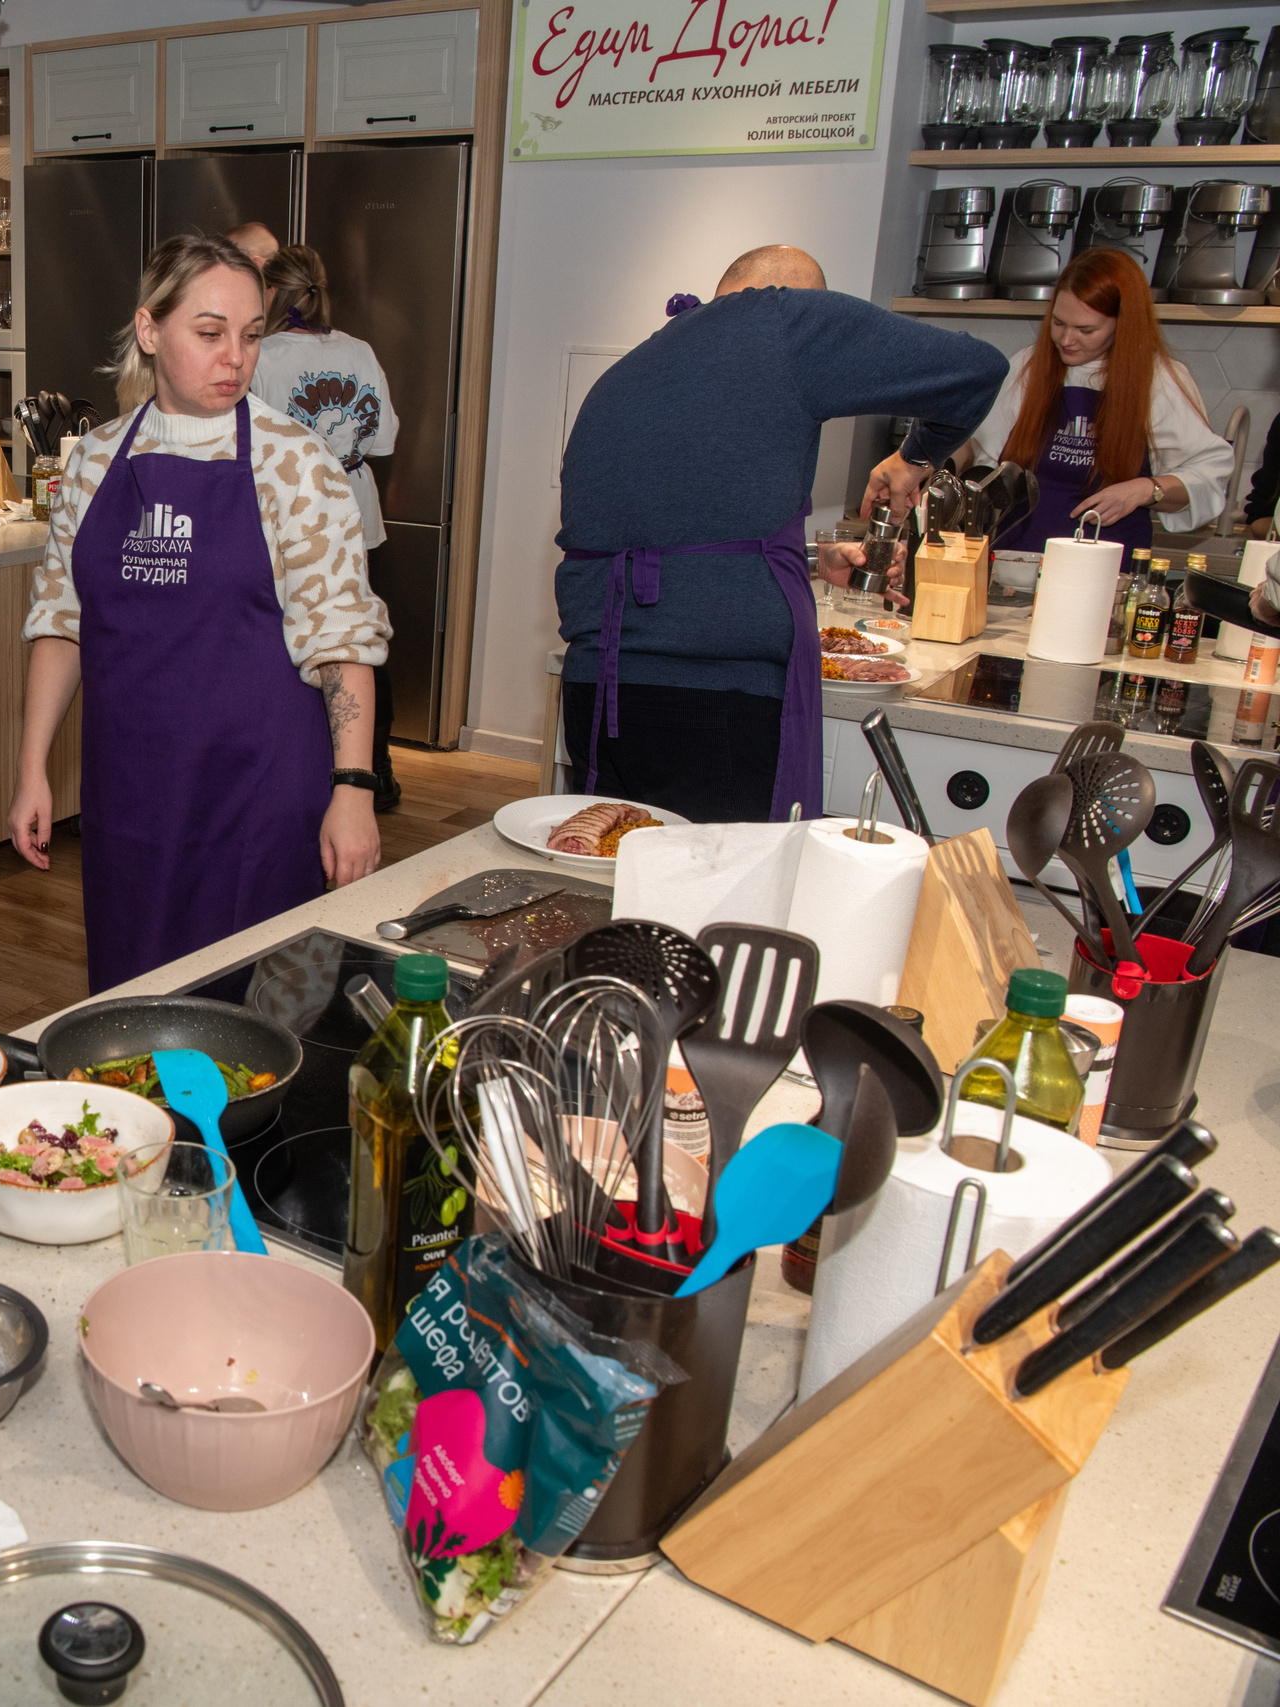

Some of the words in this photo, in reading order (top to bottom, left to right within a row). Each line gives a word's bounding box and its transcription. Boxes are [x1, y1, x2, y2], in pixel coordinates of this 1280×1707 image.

[532, 6, 653, 109] Едим
[649, 0, 838, 83] Дома!
[588, 88, 685, 107] МАСТЕРСКАЯ
[691, 79, 782, 101] КУХОННОЙ
[788, 78, 860, 96] МЕБЕЛИ
[766, 113, 819, 125] АВТОРСКИЙ
[821, 113, 856, 123] ПРОЕКТ
[747, 130, 784, 141] ЮЛИИ
[787, 125, 855, 140] ВЫСОЦКОЙ
[1049, 450, 1096, 466] СТУДИЯ
[127, 503, 192, 539] Julia
[122, 538, 192, 553] VYSOTSKAYA
[122, 554, 188, 568] КУЛИНАРНАЯ
[121, 565, 188, 586] СТУДИЯ
[1172, 627, 1197, 635] ROSSO
[1174, 619, 1198, 628] ACETO
[679, 1111, 706, 1121] setra
[412, 1225, 459, 1247] Picantel
[410, 1306, 465, 1382] шефа
